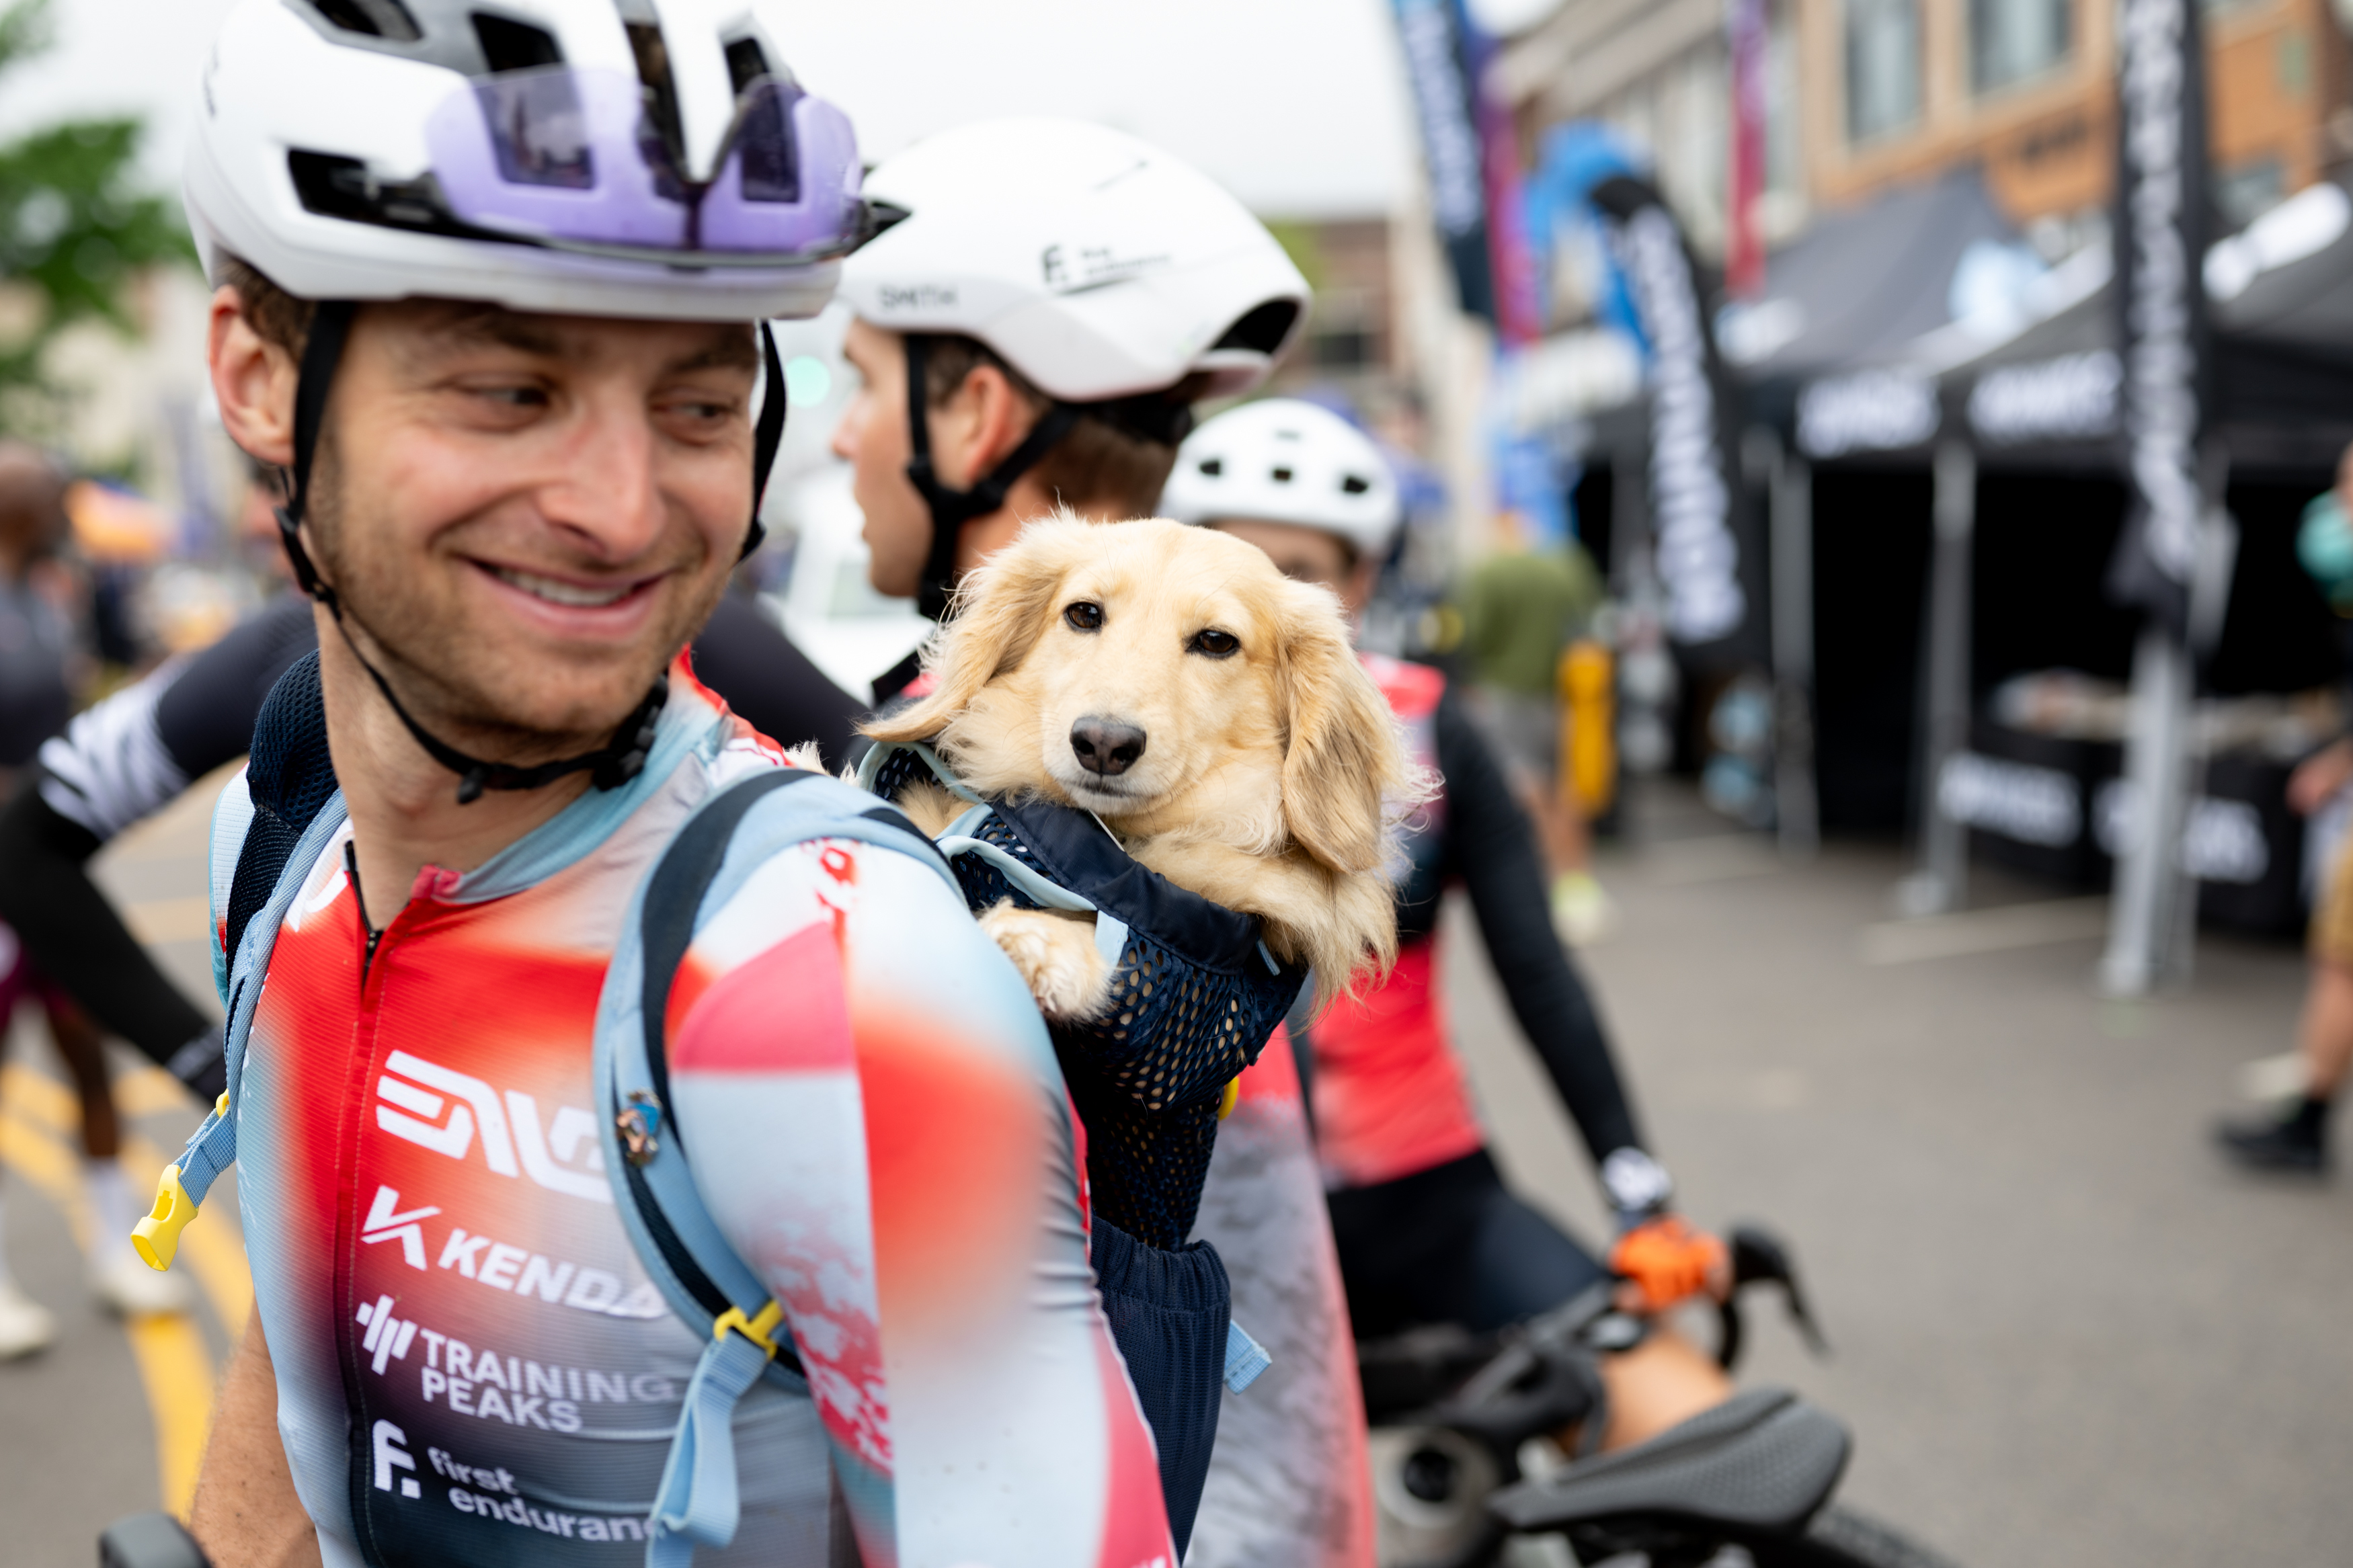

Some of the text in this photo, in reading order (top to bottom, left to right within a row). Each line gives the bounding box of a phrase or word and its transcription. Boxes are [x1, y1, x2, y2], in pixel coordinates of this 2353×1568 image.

[419, 1328, 675, 1403] TRAINING
[421, 1366, 583, 1433] PEAKS
[427, 1446, 519, 1495] first
